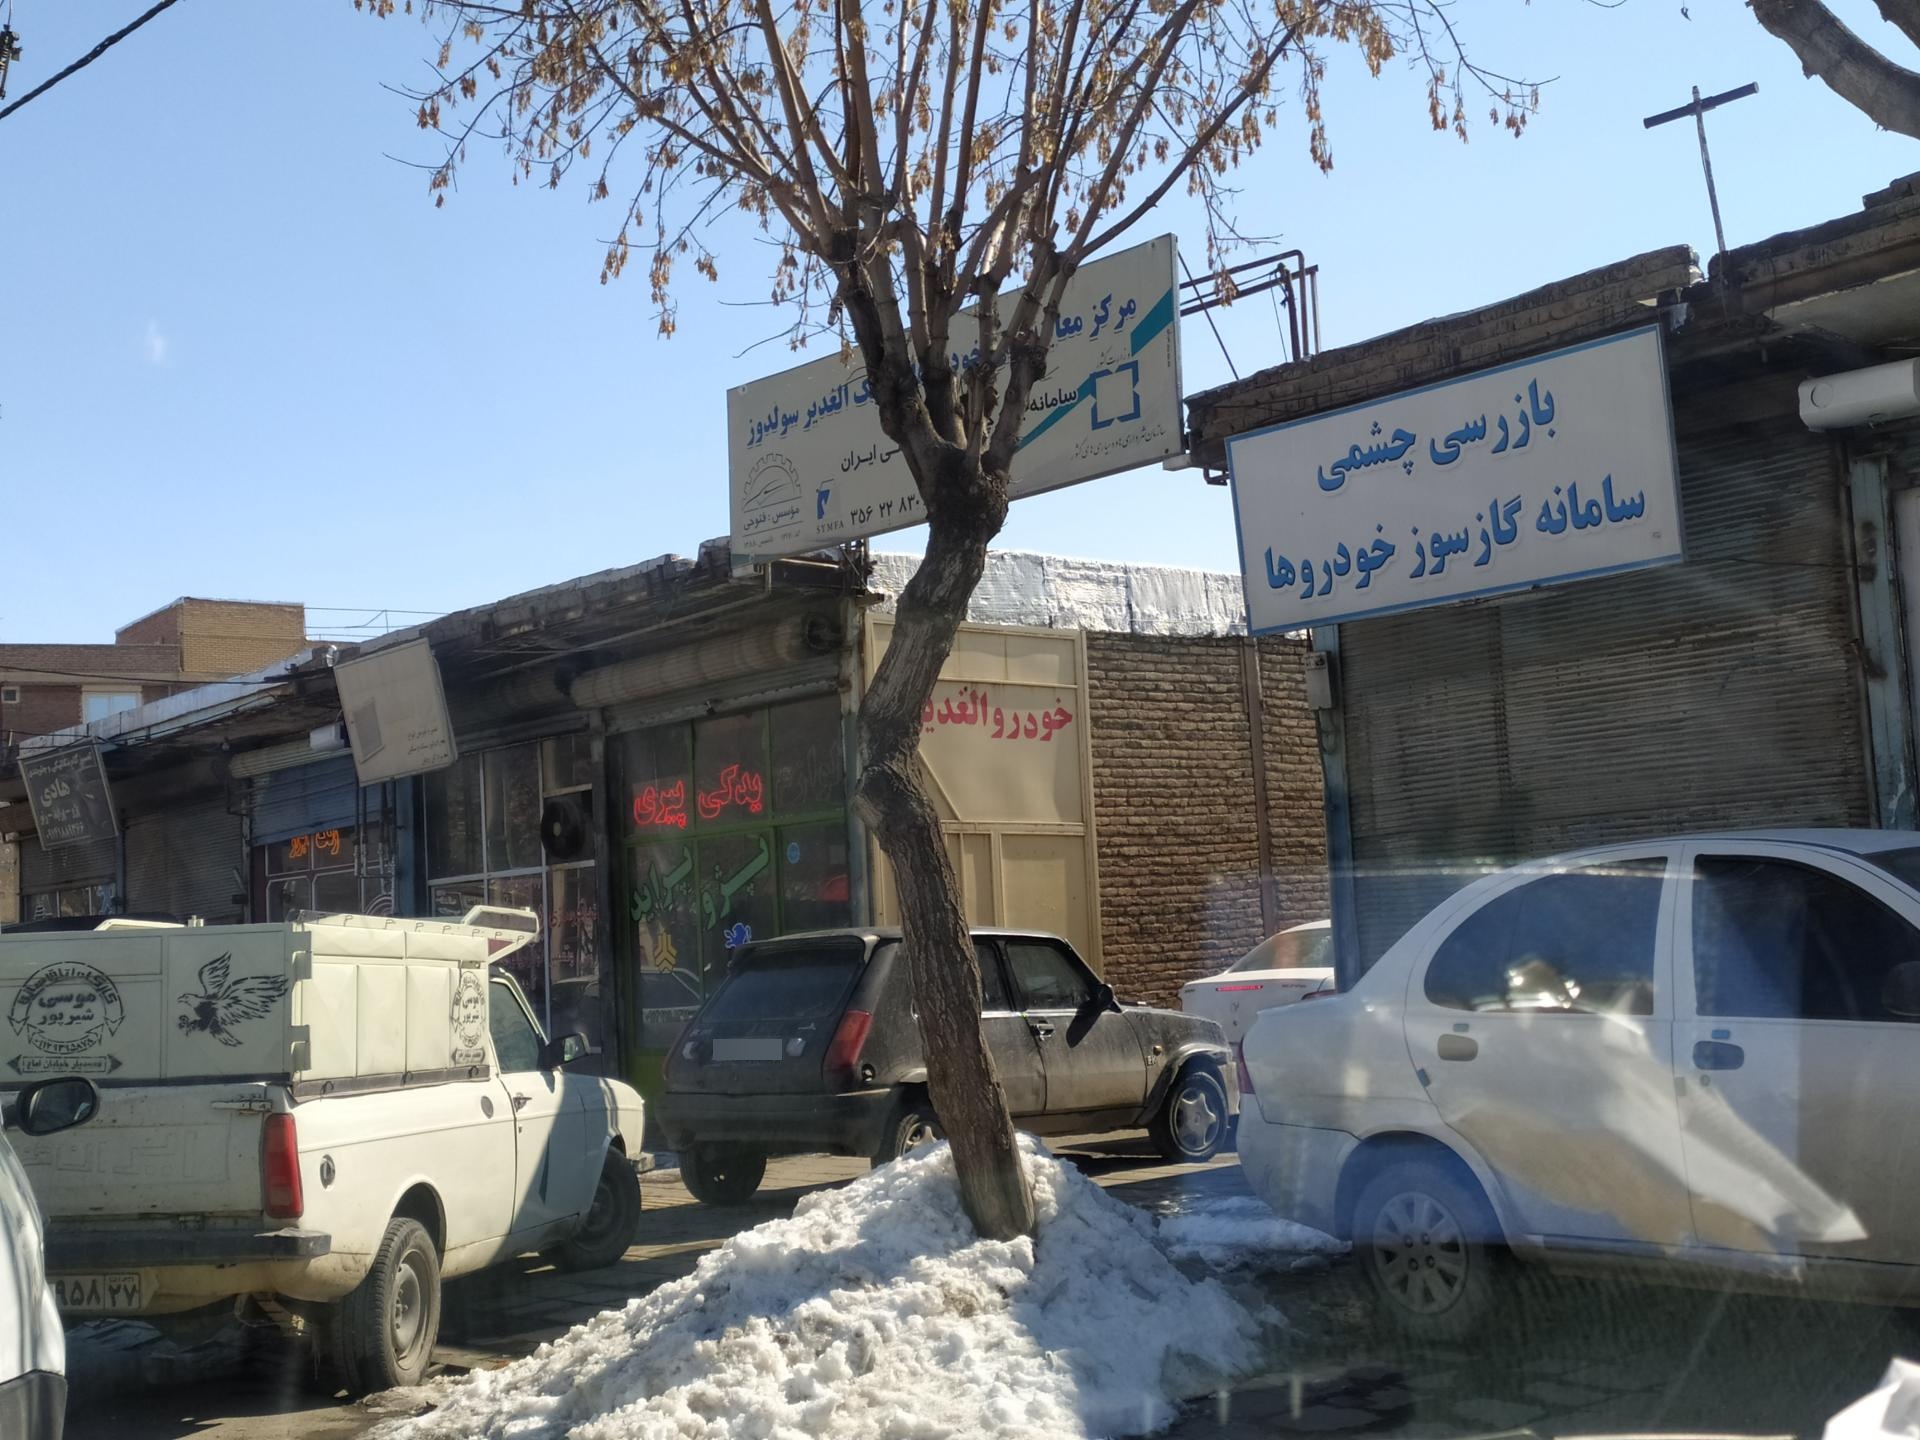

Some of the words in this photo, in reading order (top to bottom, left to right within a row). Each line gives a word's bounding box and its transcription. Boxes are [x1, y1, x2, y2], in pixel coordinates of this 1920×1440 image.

[1089, 292, 1137, 342] مرکز
[803, 383, 849, 431] الغدیر
[1030, 387, 1078, 413] سامانه
[1429, 376, 1556, 466] بازرسی
[746, 403, 799, 449] سولدوز
[840, 443, 878, 473] ایران
[1317, 420, 1417, 492] چشمی
[850, 505, 873, 525] ۳۵۶
[878, 500, 893, 518] ۲۲
[1535, 473, 1646, 536] سامانه
[1264, 522, 1397, 600] خودروها
[1409, 494, 1522, 580] گازسوز
[921, 684, 988, 734] الغدی
[991, 696, 1074, 743] خودرو
[40, 777, 70, 808] هادی
[697, 763, 763, 820] یدکی
[701, 834, 771, 932] پژو
[37, 991, 97, 1009] موسی
